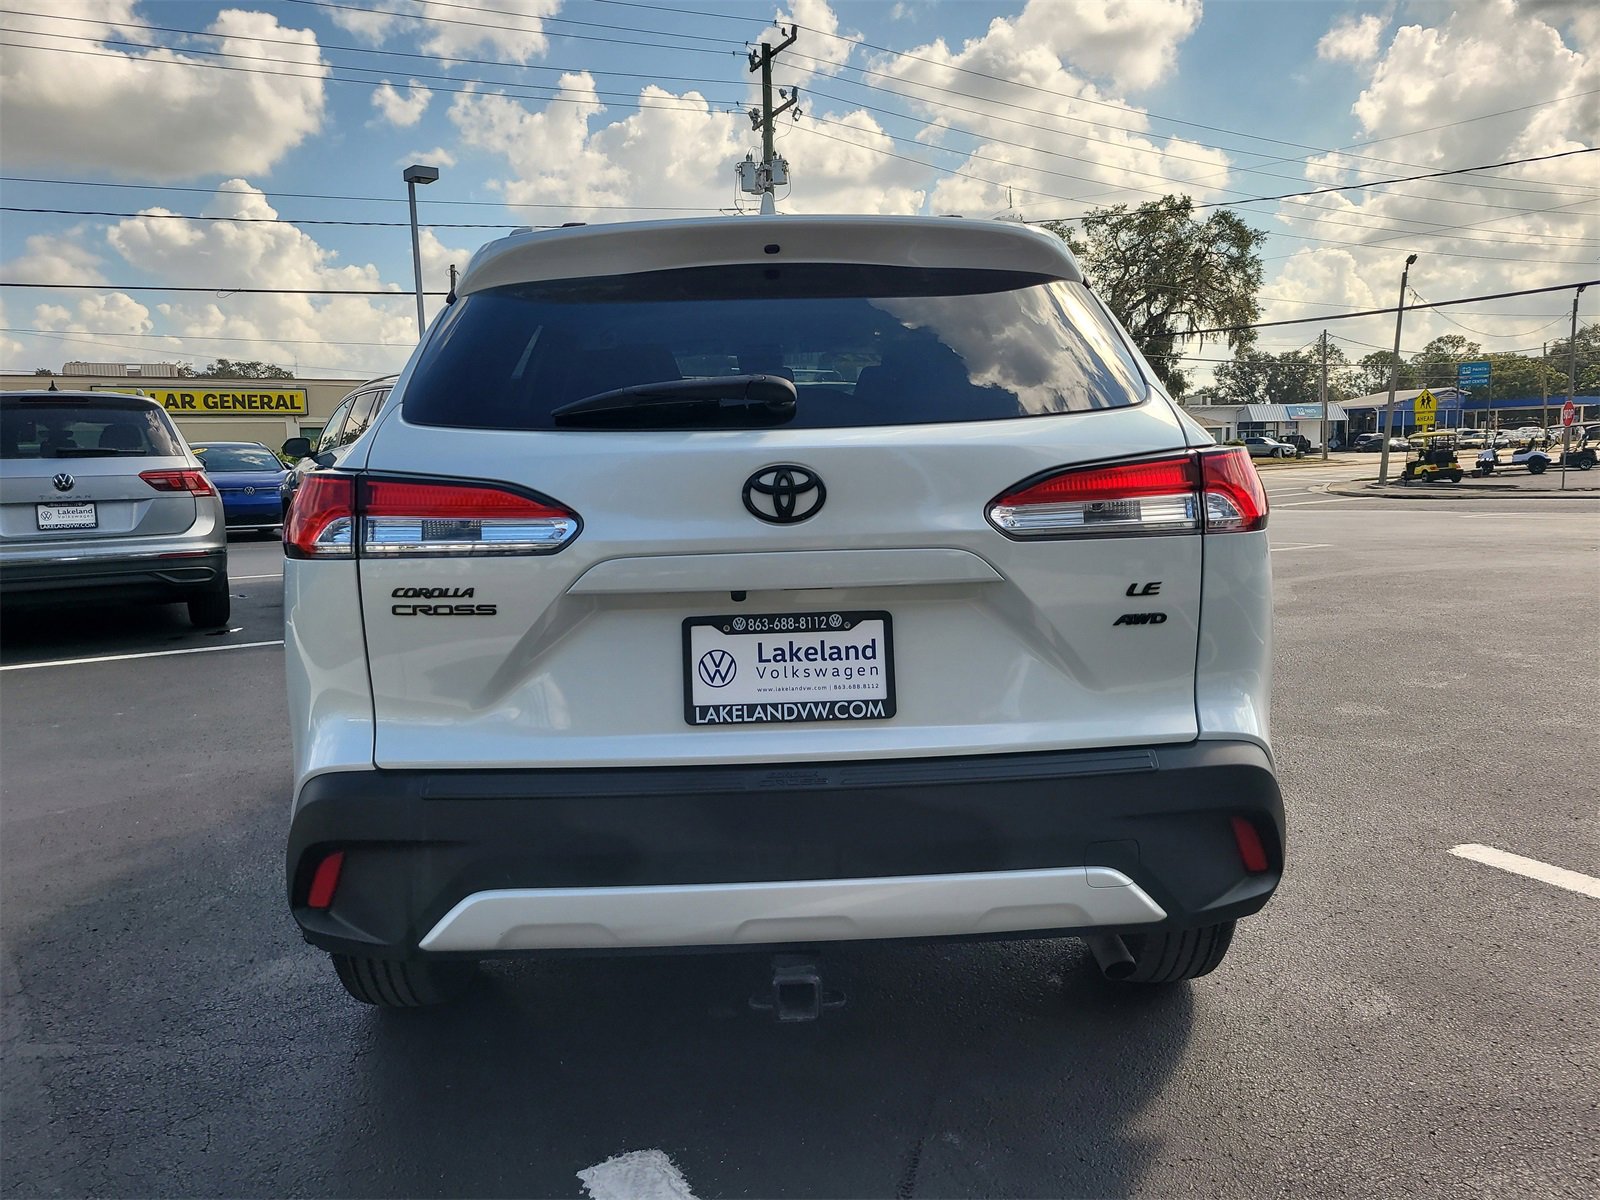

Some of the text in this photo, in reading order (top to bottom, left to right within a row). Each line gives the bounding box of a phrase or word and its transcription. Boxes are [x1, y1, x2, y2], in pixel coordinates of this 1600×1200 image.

[203, 394, 301, 410] GENERAL
[1563, 408, 1574, 419] STOP
[391, 587, 475, 599] COROLLA
[1125, 581, 1162, 597] LE
[391, 604, 497, 616] CROSS
[747, 616, 827, 631] 863-688-8112
[1112, 612, 1168, 626] AWD
[757, 639, 877, 663] Lakeland
[755, 665, 879, 680] Volkswagen
[757, 685, 828, 693] www.lakelandvw.com
[695, 700, 886, 724] LAKELANDVW.COM
